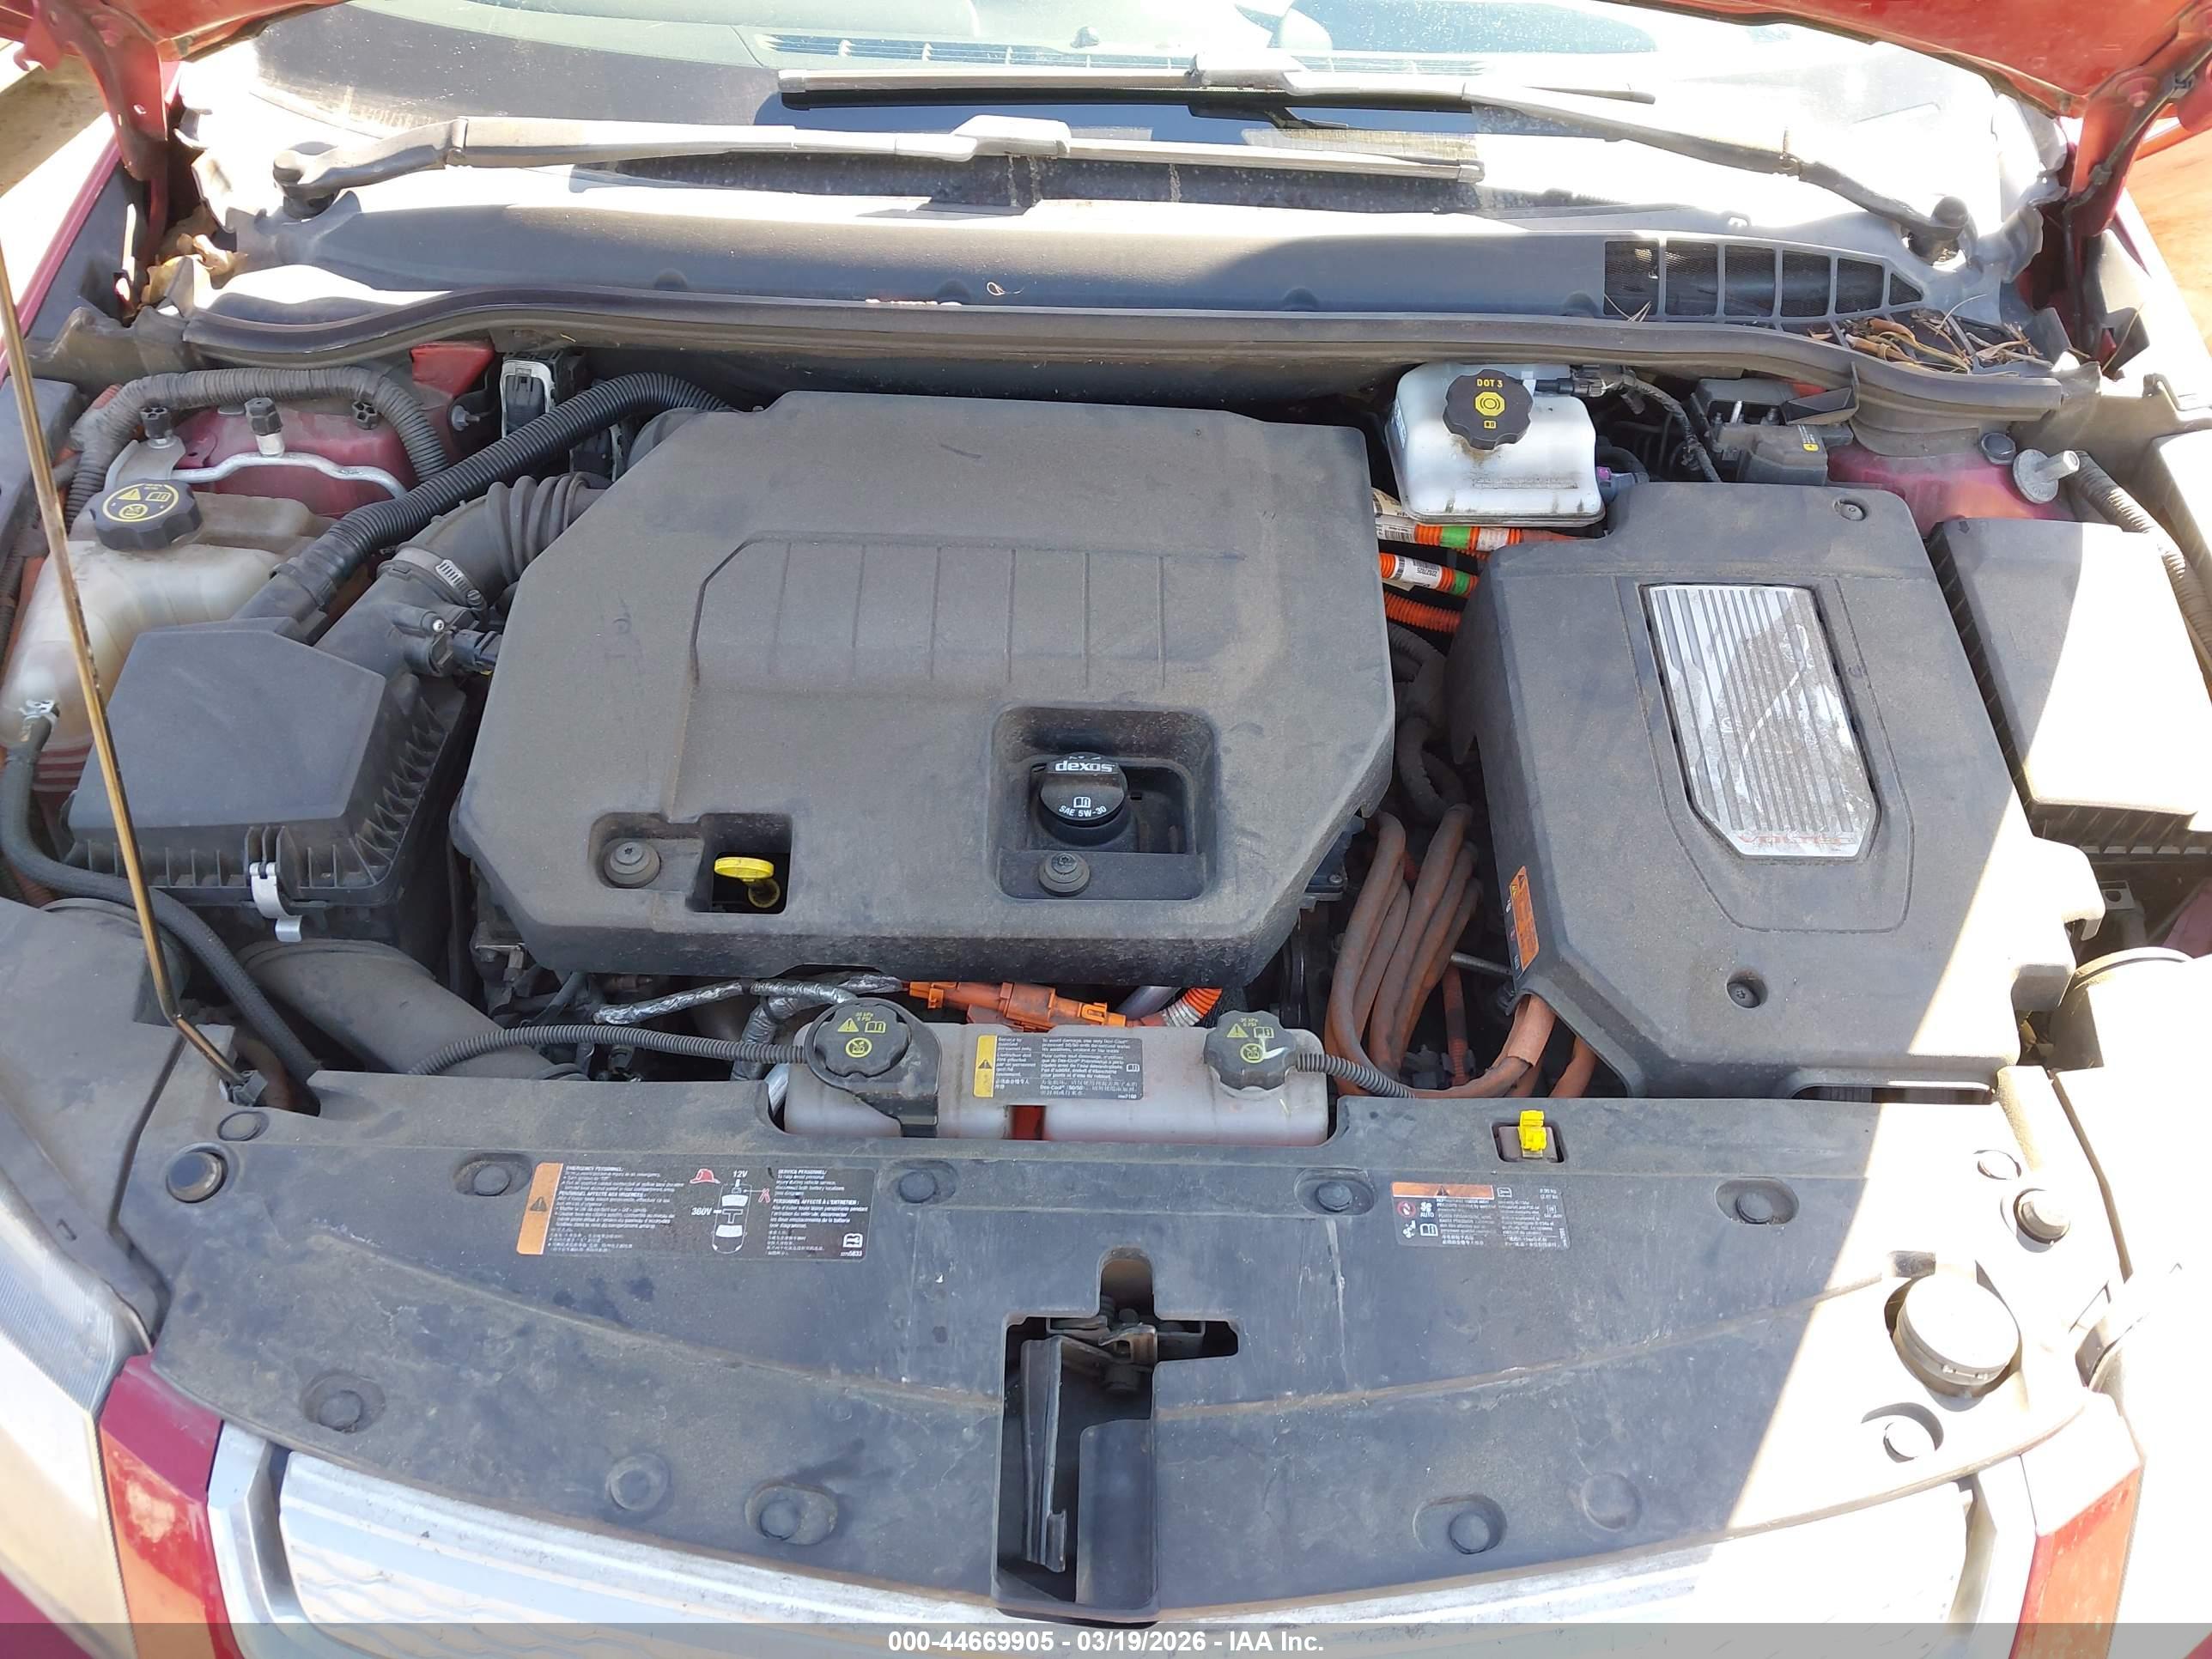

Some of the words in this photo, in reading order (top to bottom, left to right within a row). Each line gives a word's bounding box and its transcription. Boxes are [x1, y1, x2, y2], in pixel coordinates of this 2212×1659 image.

[1055, 761, 1113, 772] dexos
[1059, 805, 1075, 816] SAE
[1078, 805, 1107, 817] 5W-30
